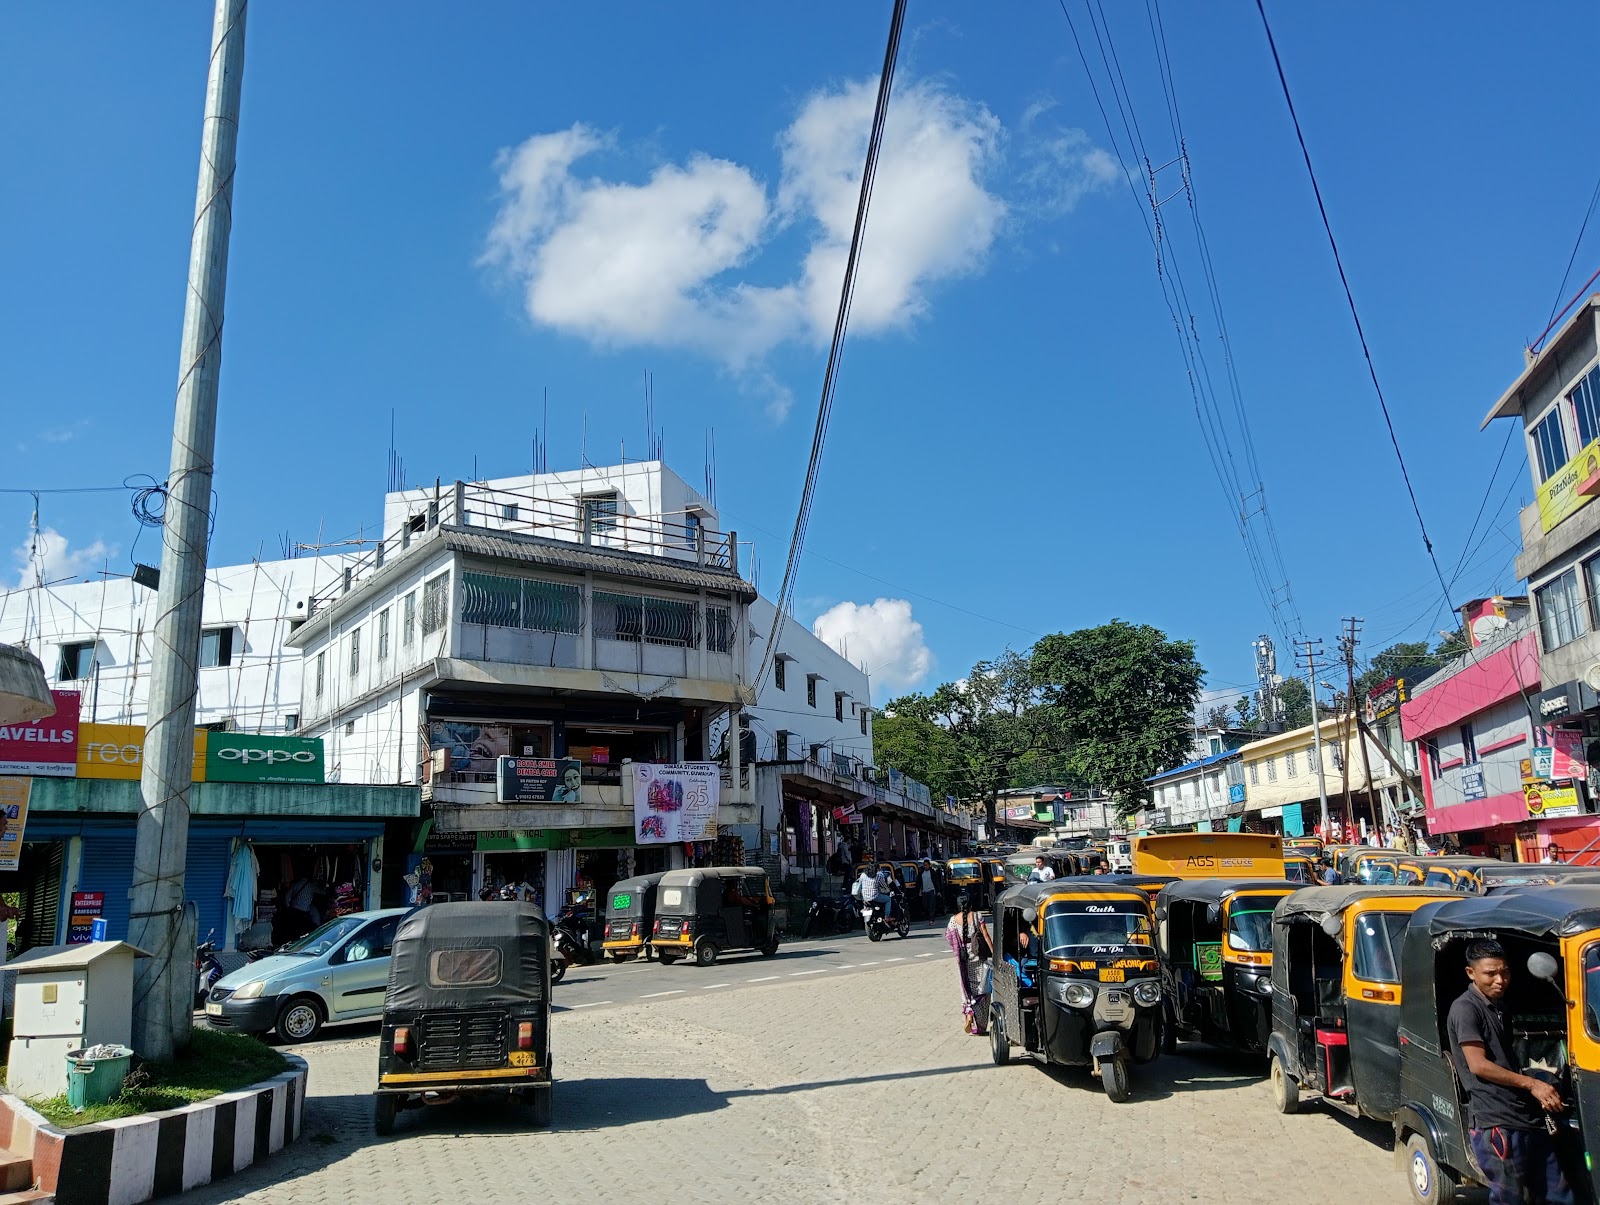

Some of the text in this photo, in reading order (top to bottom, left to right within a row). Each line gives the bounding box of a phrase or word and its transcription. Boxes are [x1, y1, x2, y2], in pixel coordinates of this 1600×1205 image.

[517, 760, 537, 768] ROYAL
[517, 768, 558, 777] DENTAL CARE
[686, 785, 710, 811] 25
[1186, 856, 1214, 867] AGS
[1085, 905, 1115, 913] Ruth
[1080, 961, 1096, 970] NEW
